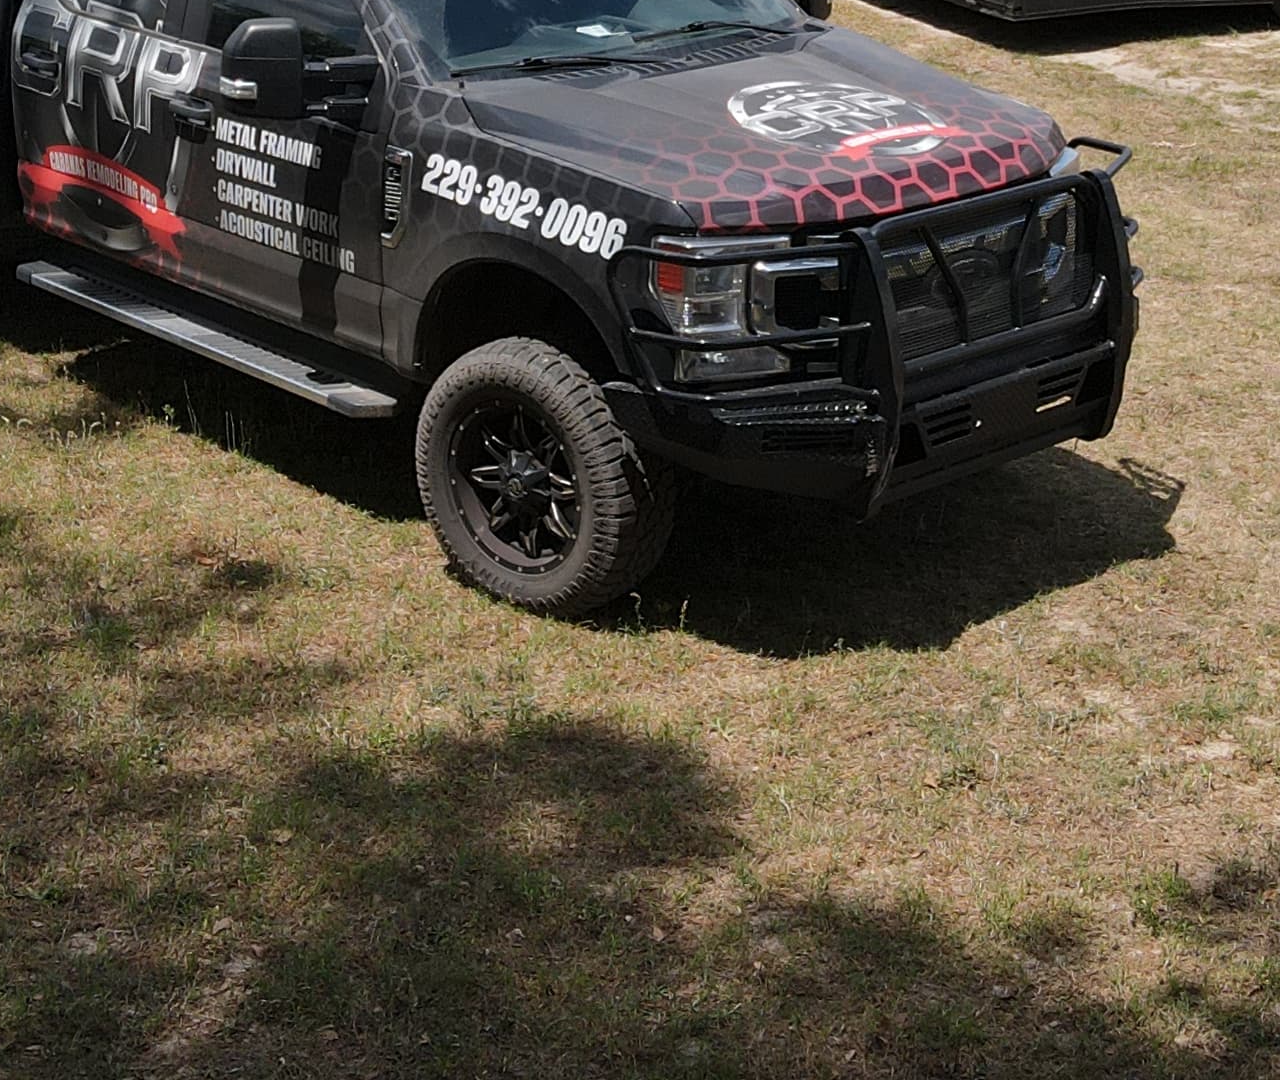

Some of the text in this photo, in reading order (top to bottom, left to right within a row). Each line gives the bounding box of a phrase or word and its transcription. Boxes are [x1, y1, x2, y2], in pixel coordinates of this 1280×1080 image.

[215, 117, 322, 170] METAL FRAMING
[745, 92, 907, 140] CRP
[48, 151, 158, 214] CABANAS REMODELING PRO
[216, 148, 277, 188] DRYWALL
[217, 178, 340, 238] CARPENTER WORK
[220, 209, 356, 274] ACOUSTICAL CEILING
